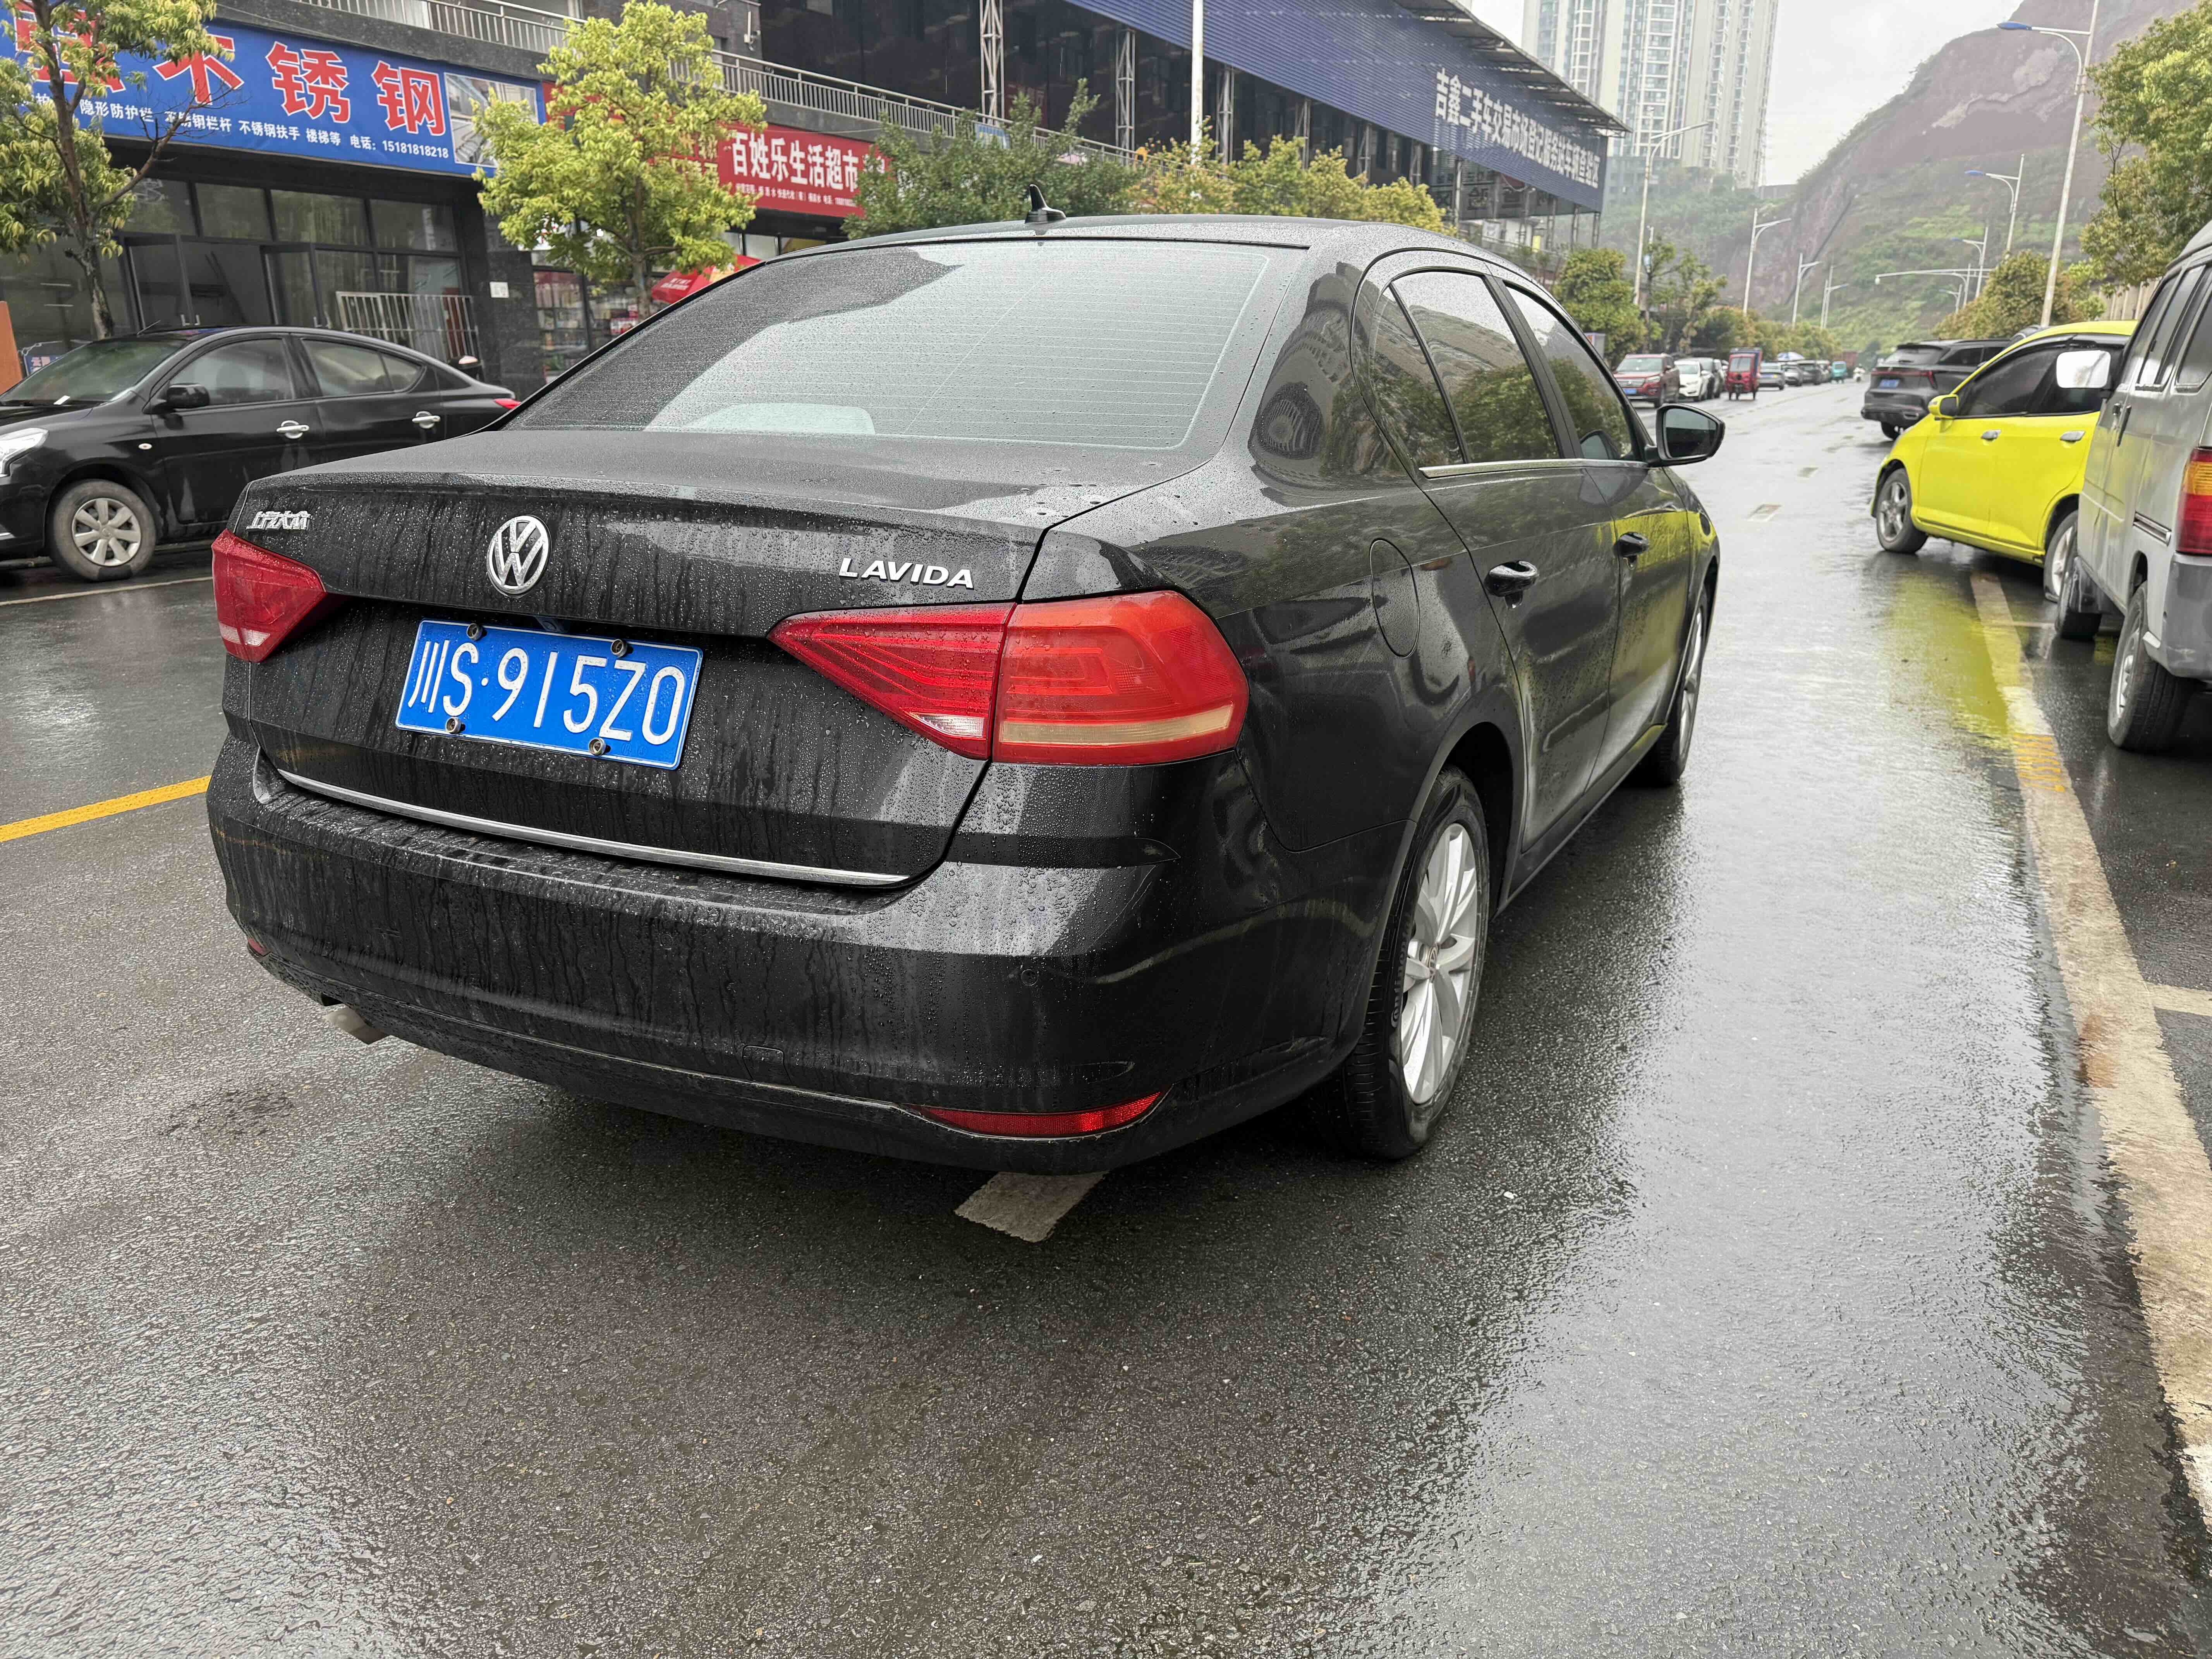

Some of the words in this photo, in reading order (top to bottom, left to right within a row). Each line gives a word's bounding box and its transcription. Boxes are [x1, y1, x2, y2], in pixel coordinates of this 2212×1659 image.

[79, 99, 154, 122] 隐形防护栏
[164, 111, 232, 132] 不锈钢栏杆
[238, 120, 301, 141] 不锈钢扶手
[306, 127, 341, 146] 楼梯等
[382, 140, 449, 158] 15181818218
[731, 131, 859, 192] 百姓乐生活超市
[838, 557, 974, 589] LAVIDA
[407, 639, 685, 745] 川S·915Z0
